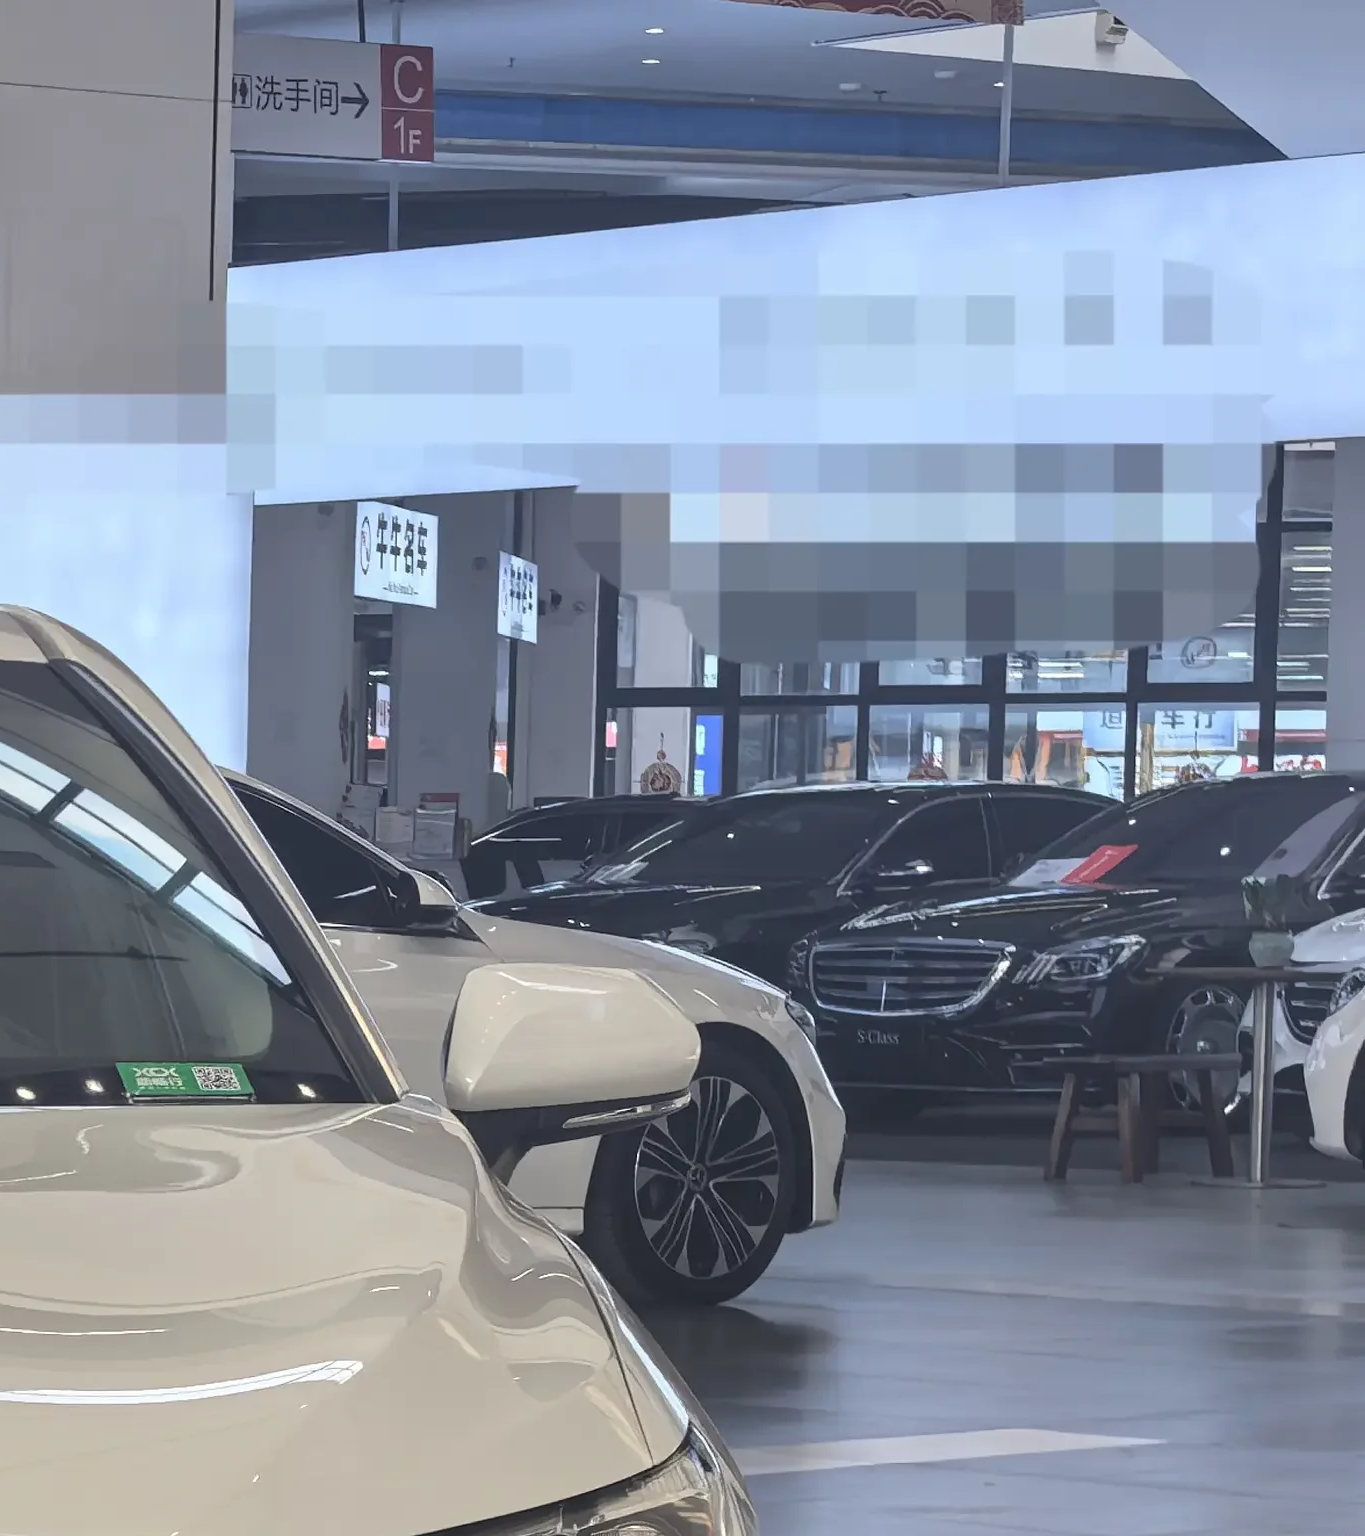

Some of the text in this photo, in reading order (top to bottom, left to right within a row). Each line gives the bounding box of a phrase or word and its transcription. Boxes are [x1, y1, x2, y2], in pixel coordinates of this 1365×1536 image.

[254, 75, 339, 116] 洗手间
[393, 55, 425, 104] C
[393, 116, 422, 154] 1F
